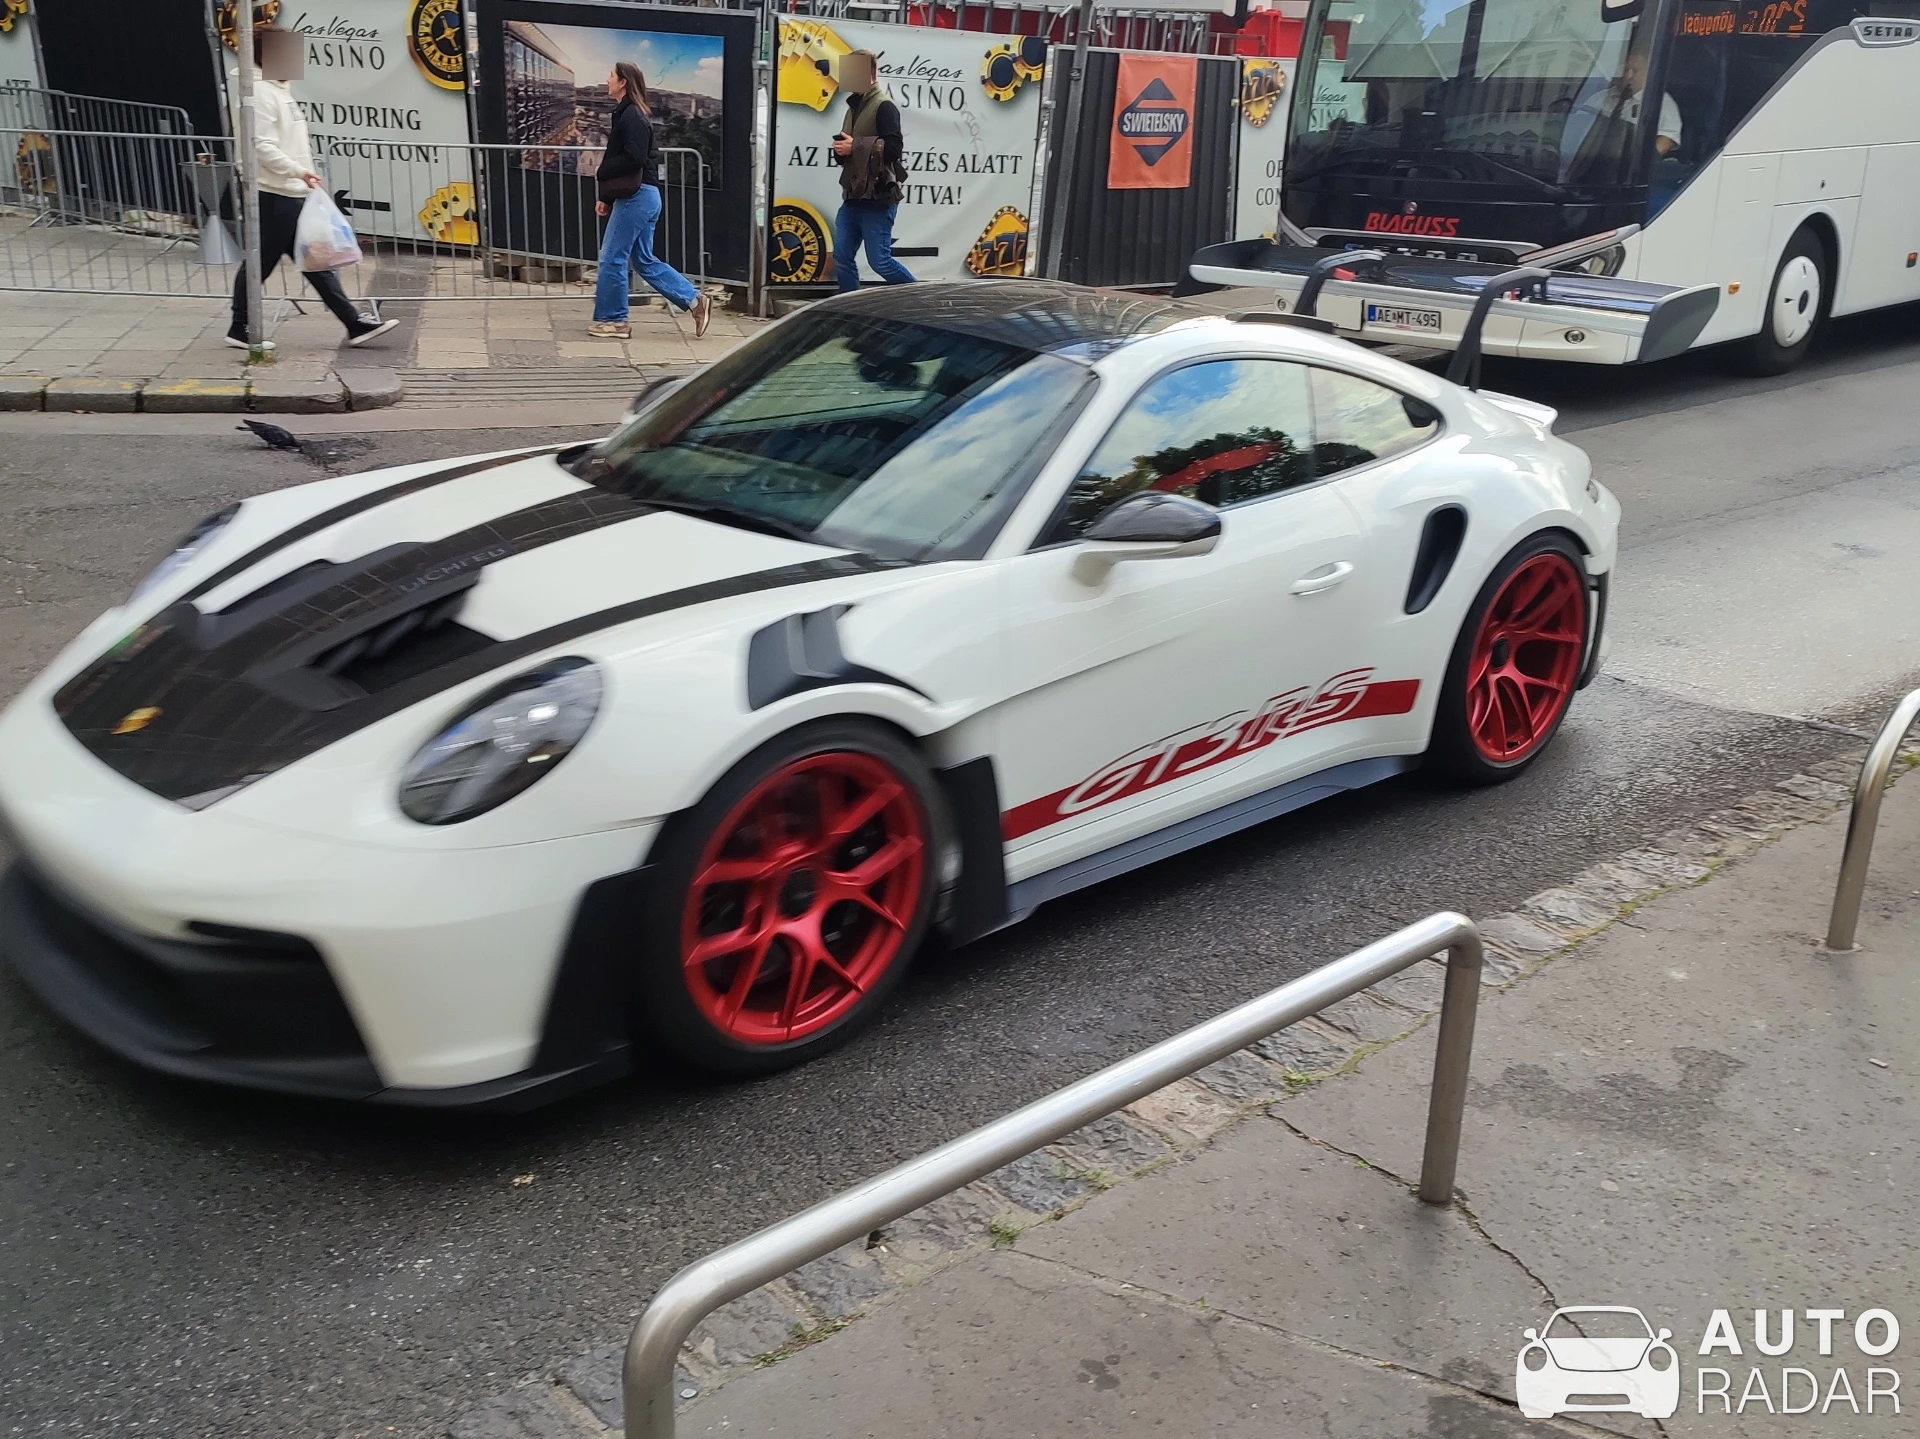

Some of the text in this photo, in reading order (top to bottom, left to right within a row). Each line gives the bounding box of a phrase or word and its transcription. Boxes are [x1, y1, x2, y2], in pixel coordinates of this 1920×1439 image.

[327, 16, 380, 43] Vegas
[1863, 25, 1913, 37] SETRA
[308, 43, 385, 70] ASINO
[908, 54, 965, 83] Vegas
[331, 103, 422, 131] DURING
[1122, 112, 1185, 133] SWIETELSKY
[309, 133, 439, 164] TRUCTION!
[788, 146, 819, 167] AZ
[954, 153, 1023, 174] ALATT
[900, 184, 962, 206] ITVA!
[1364, 212, 1461, 237] BLAGUSS
